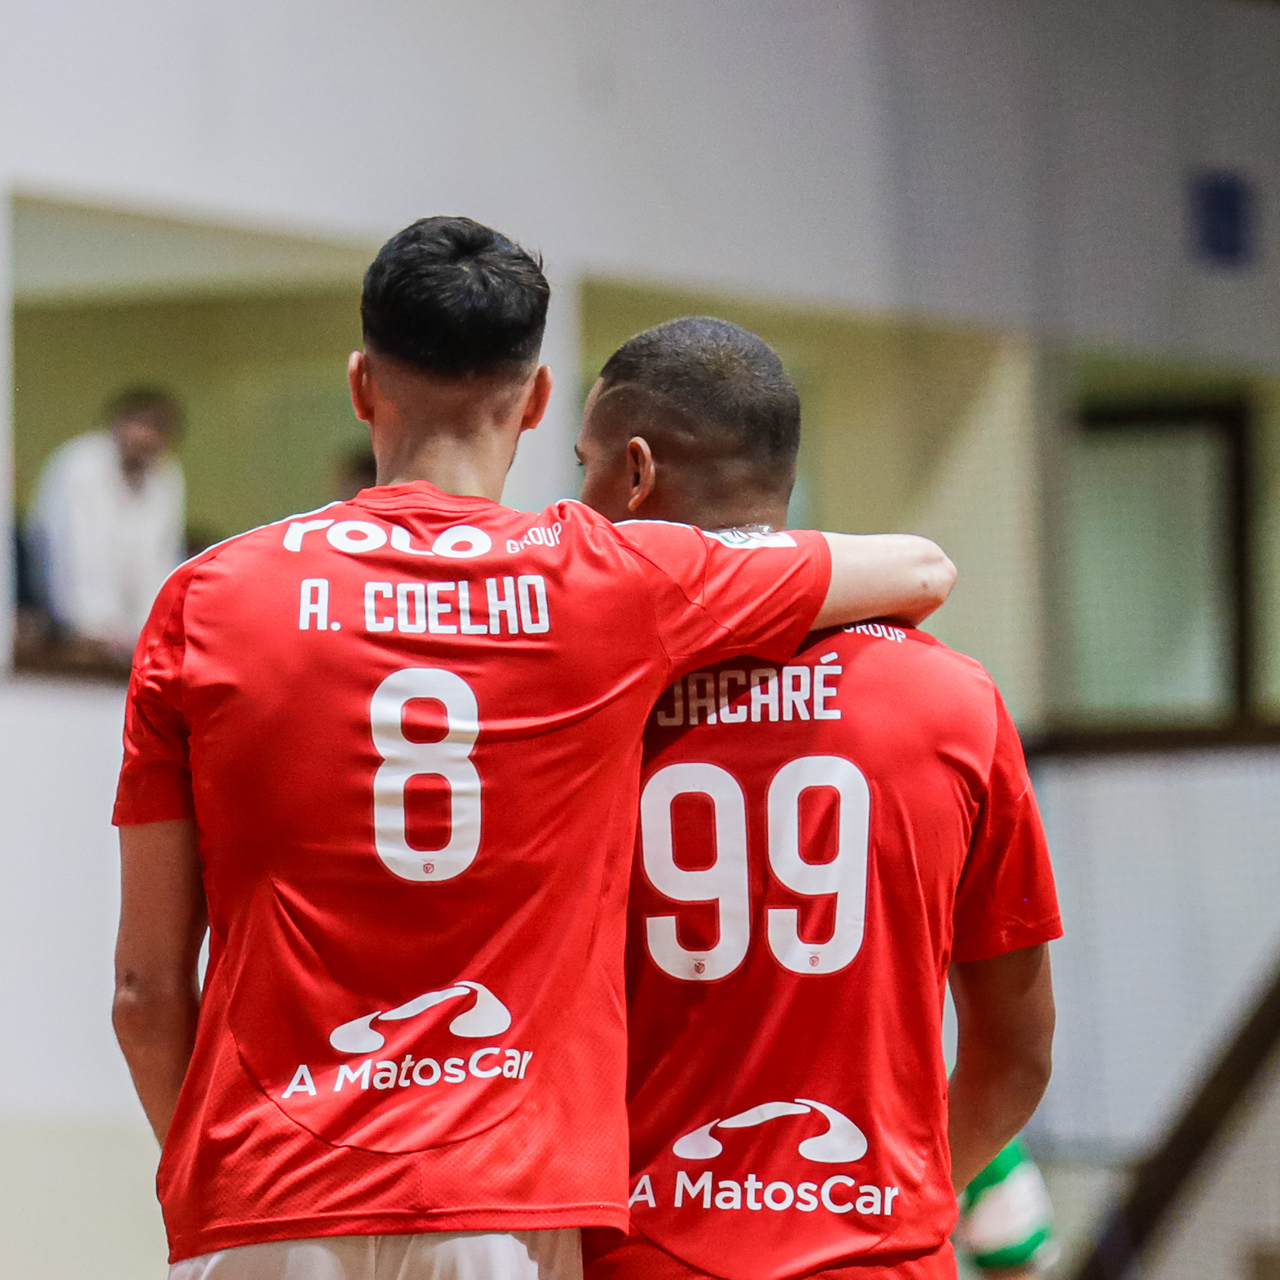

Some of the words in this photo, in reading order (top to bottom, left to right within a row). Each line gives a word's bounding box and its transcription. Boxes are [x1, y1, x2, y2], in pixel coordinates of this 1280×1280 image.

[506, 521, 563, 554] GROUP
[298, 577, 342, 631] A.
[363, 574, 550, 635] COELHO
[656, 651, 843, 727] JACARÉ
[368, 667, 482, 882] 8
[640, 755, 871, 981] 99
[281, 1064, 318, 1099] A
[333, 1046, 534, 1092] MatosCar
[628, 1174, 657, 1209] A
[673, 1170, 900, 1217] MatosCar
